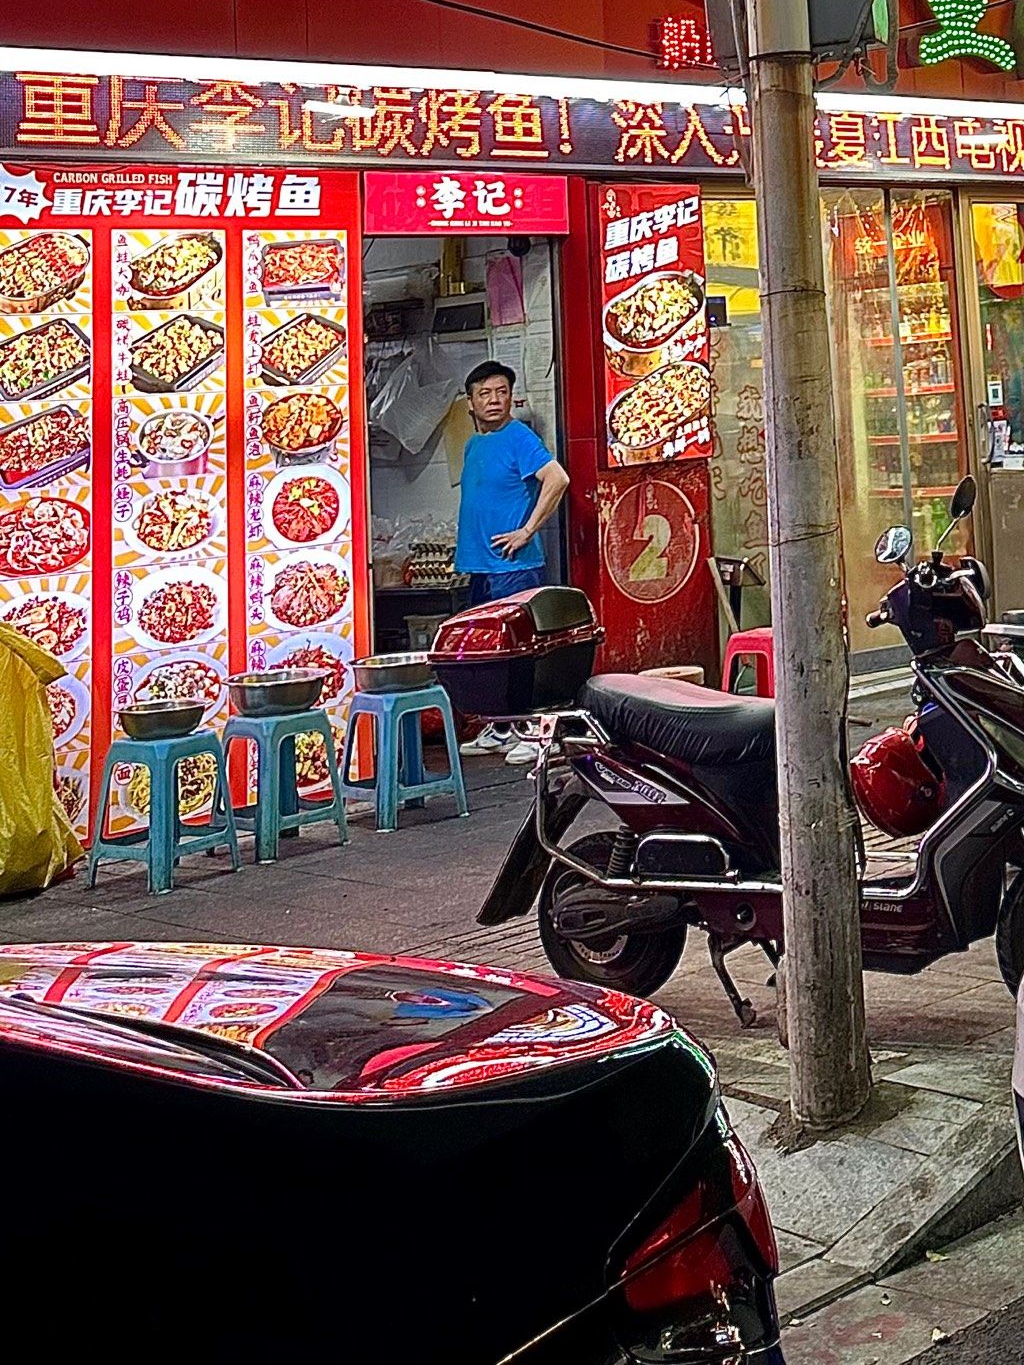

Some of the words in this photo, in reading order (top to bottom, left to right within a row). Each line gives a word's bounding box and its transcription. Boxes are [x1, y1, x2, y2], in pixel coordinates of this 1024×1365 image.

[53, 172, 98, 185] CARBON
[101, 173, 146, 185] GRILLED
[148, 174, 173, 186] FISH
[430, 176, 511, 219] 李记
[604, 195, 700, 251] 重庆李记
[605, 236, 679, 284] 碳烤鱼
[628, 514, 672, 582] 2
[115, 572, 131, 623] 辣子鸡
